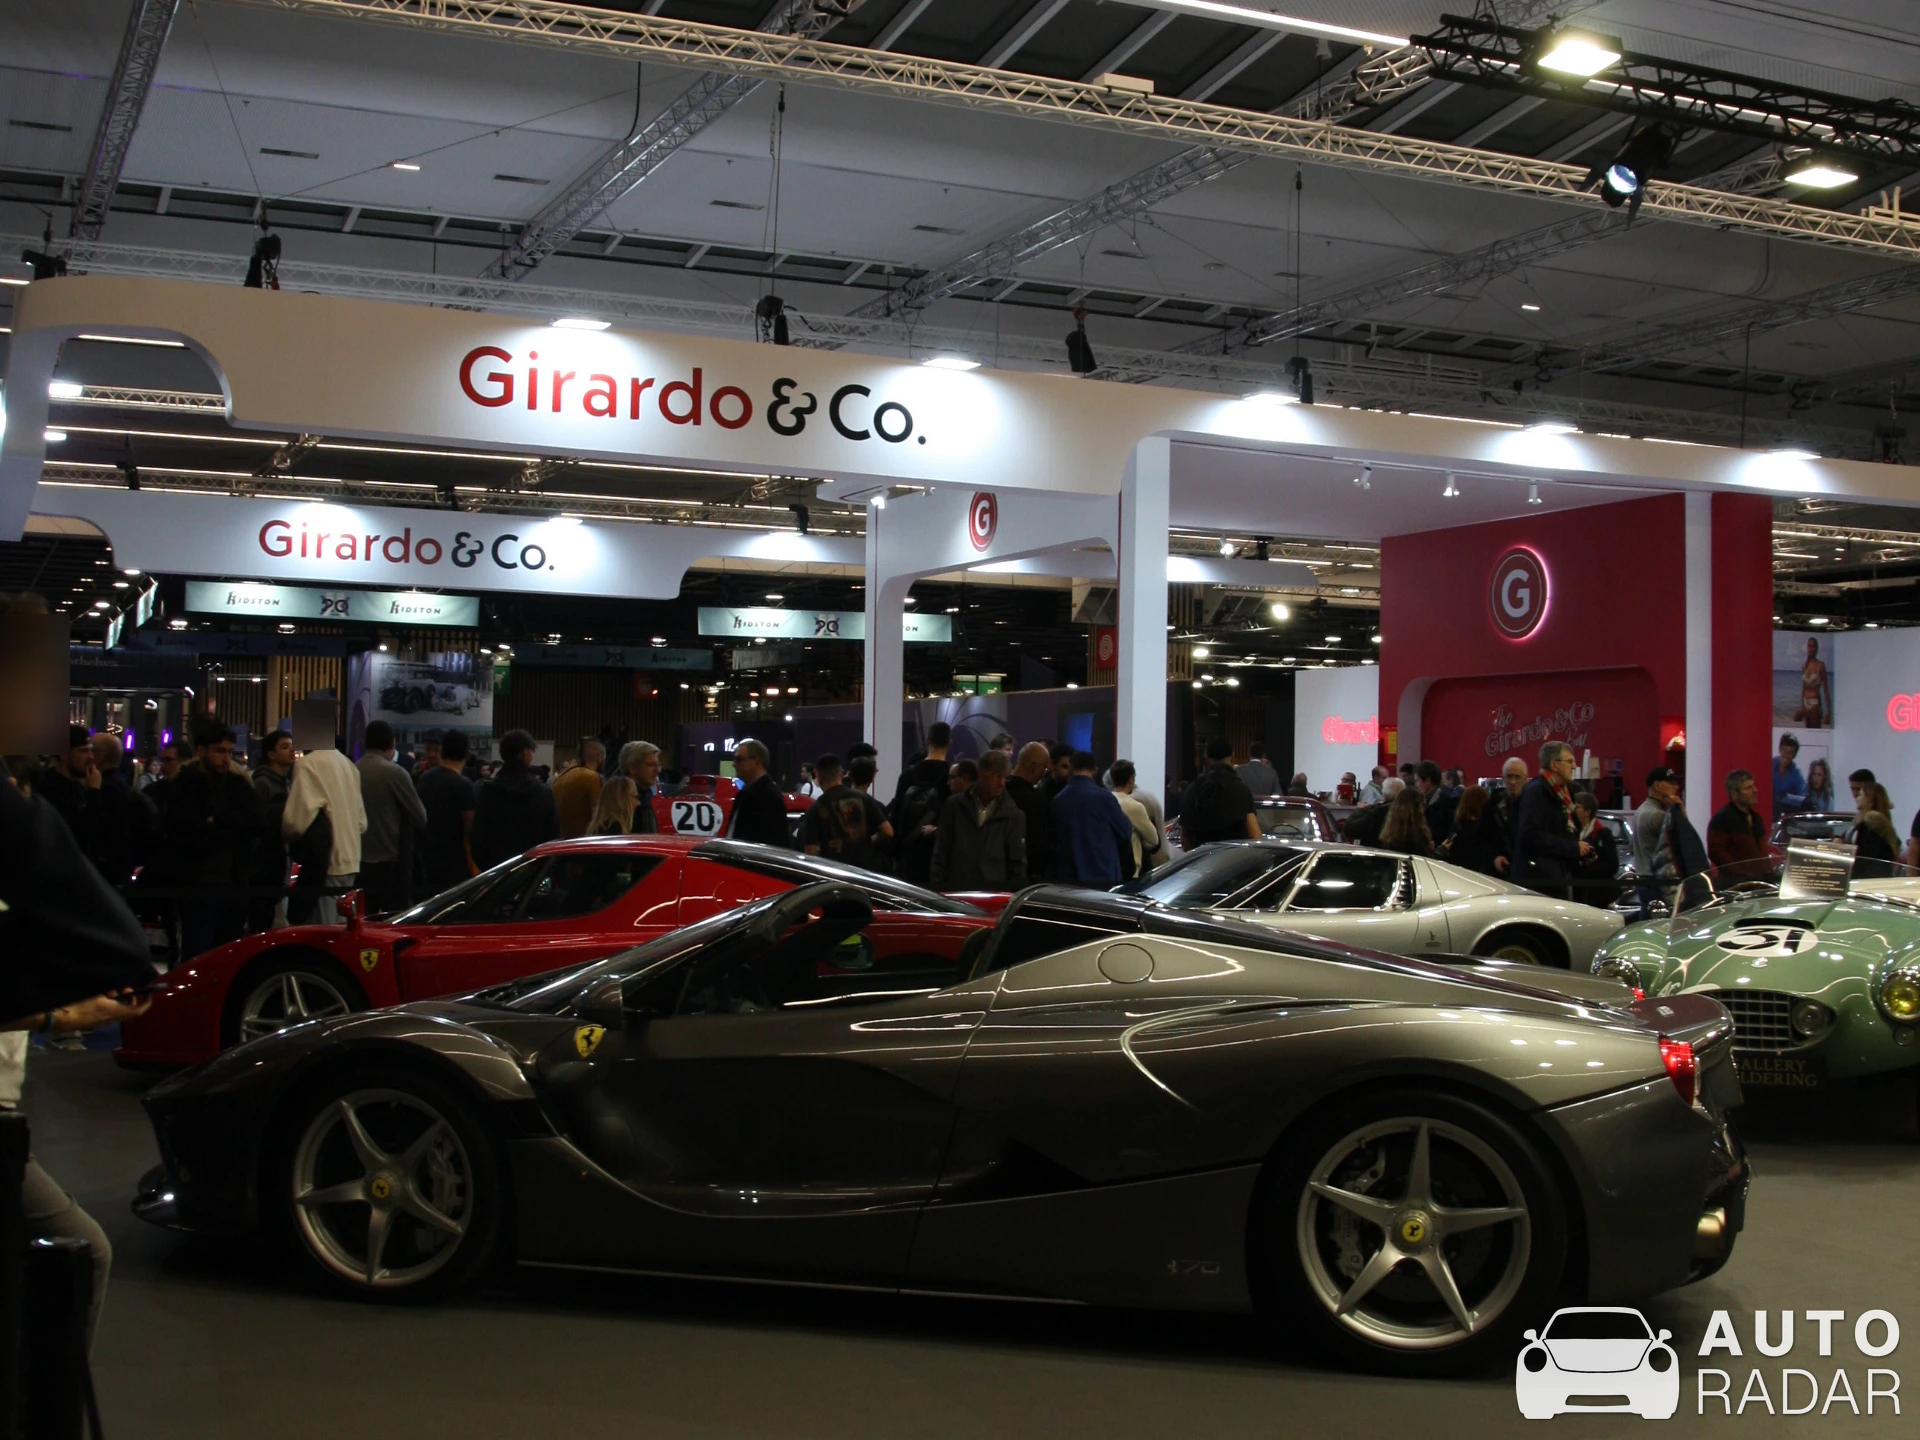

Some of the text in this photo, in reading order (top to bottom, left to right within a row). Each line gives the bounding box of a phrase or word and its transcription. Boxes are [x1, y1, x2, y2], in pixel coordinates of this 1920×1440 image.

[459, 345, 927, 445] Girardo & Co.
[974, 499, 990, 537] G
[258, 519, 554, 571] Girardo & Co.
[1501, 568, 1530, 618] G
[1322, 715, 1379, 744] Girard
[675, 802, 716, 832] 20
[1718, 928, 1806, 954] 31
[1740, 1071, 1818, 1087] LDERING
[1741, 1058, 1807, 1074] ALLERY
